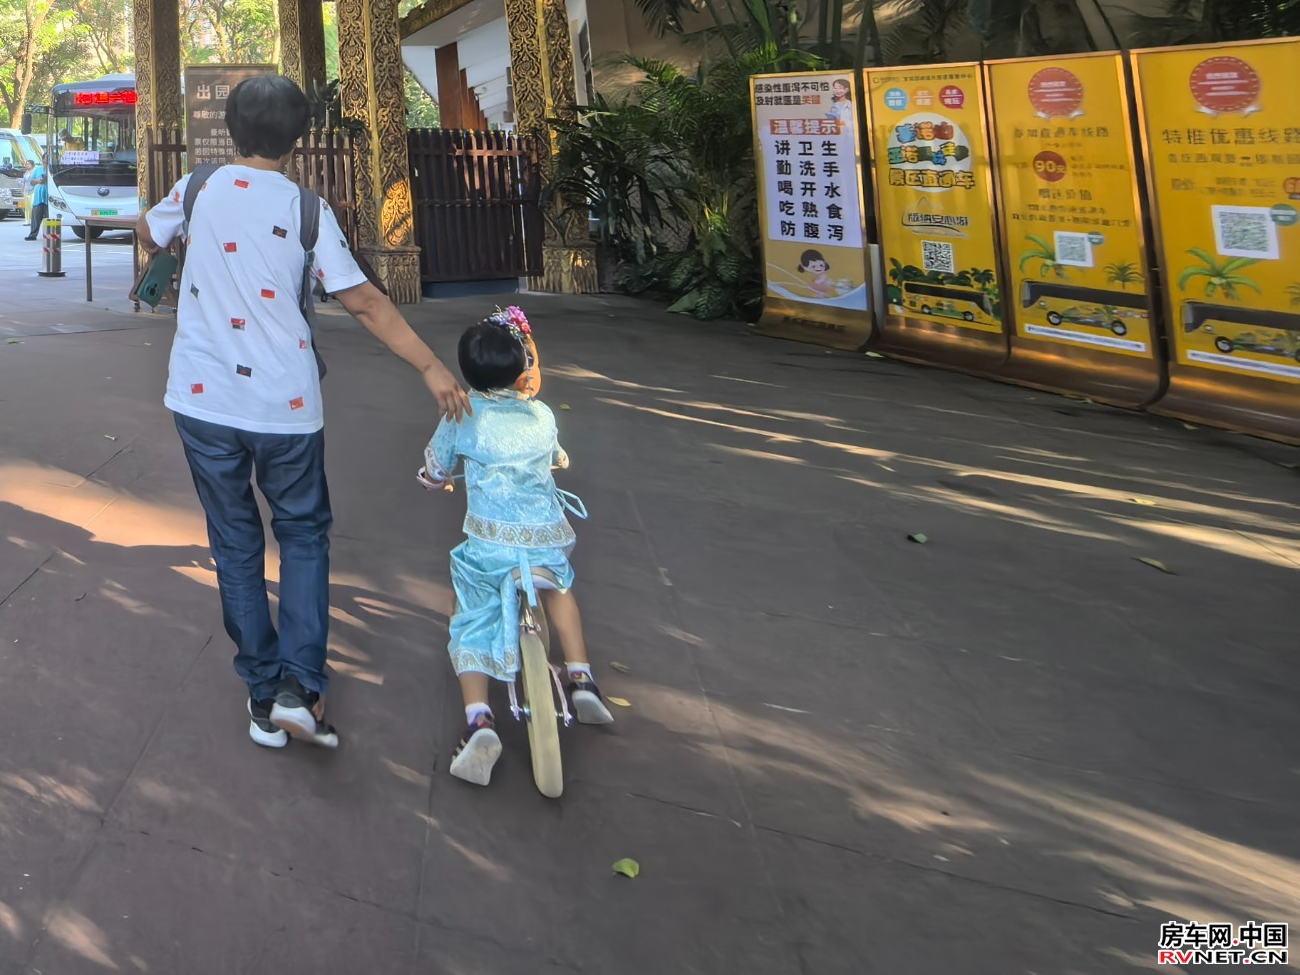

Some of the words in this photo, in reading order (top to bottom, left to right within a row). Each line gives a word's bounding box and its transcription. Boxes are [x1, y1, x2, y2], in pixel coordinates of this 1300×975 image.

[773, 118, 837, 135] 温馨提示
[775, 139, 839, 157] 讲卫生
[775, 159, 840, 178] 勤洗手
[888, 167, 976, 190] 景区直通车
[777, 180, 842, 199] 喝开水
[779, 200, 843, 220] 吃熟食
[780, 220, 844, 242] 防腹泻
